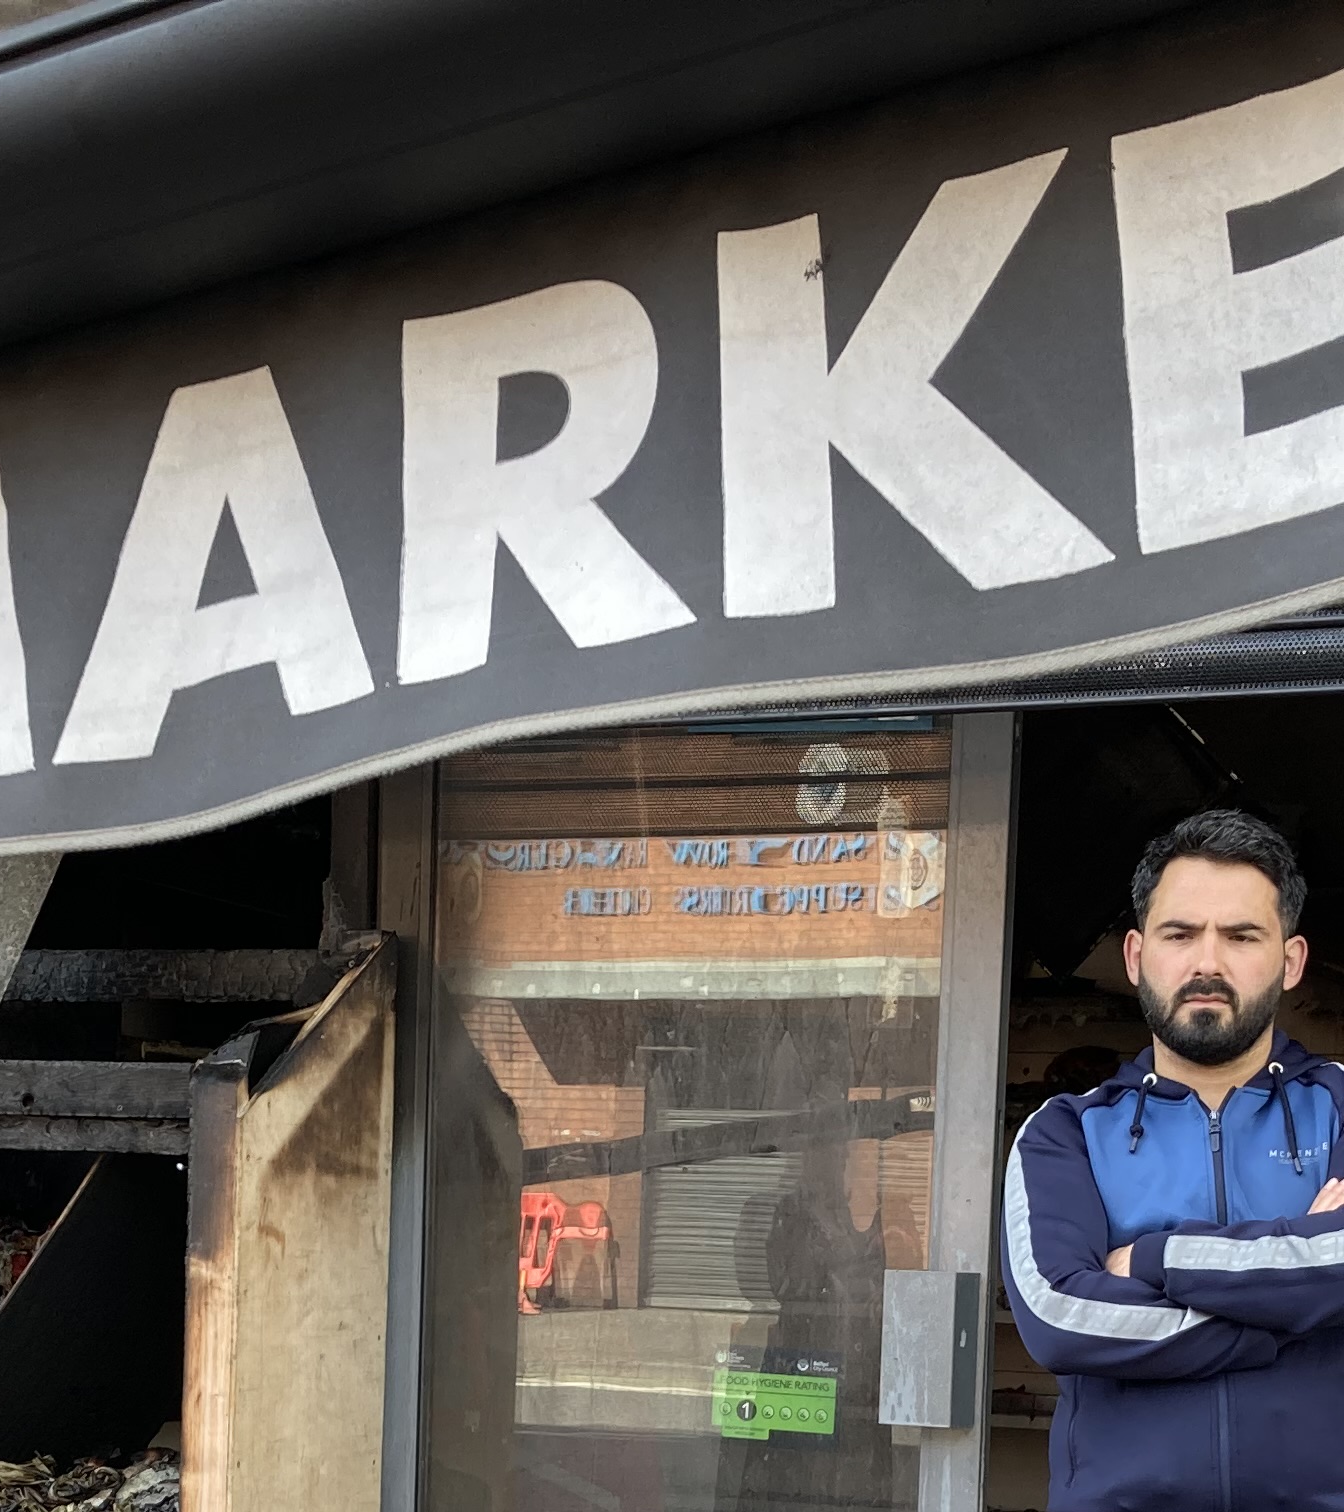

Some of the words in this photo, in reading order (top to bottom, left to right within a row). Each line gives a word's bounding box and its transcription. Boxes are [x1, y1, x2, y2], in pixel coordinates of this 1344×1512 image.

[720, 1375, 750, 1386] FOOD
[751, 1377, 794, 1390] HYGIENE
[794, 1380, 830, 1392] RATING
[741, 1402, 751, 1419] 1
